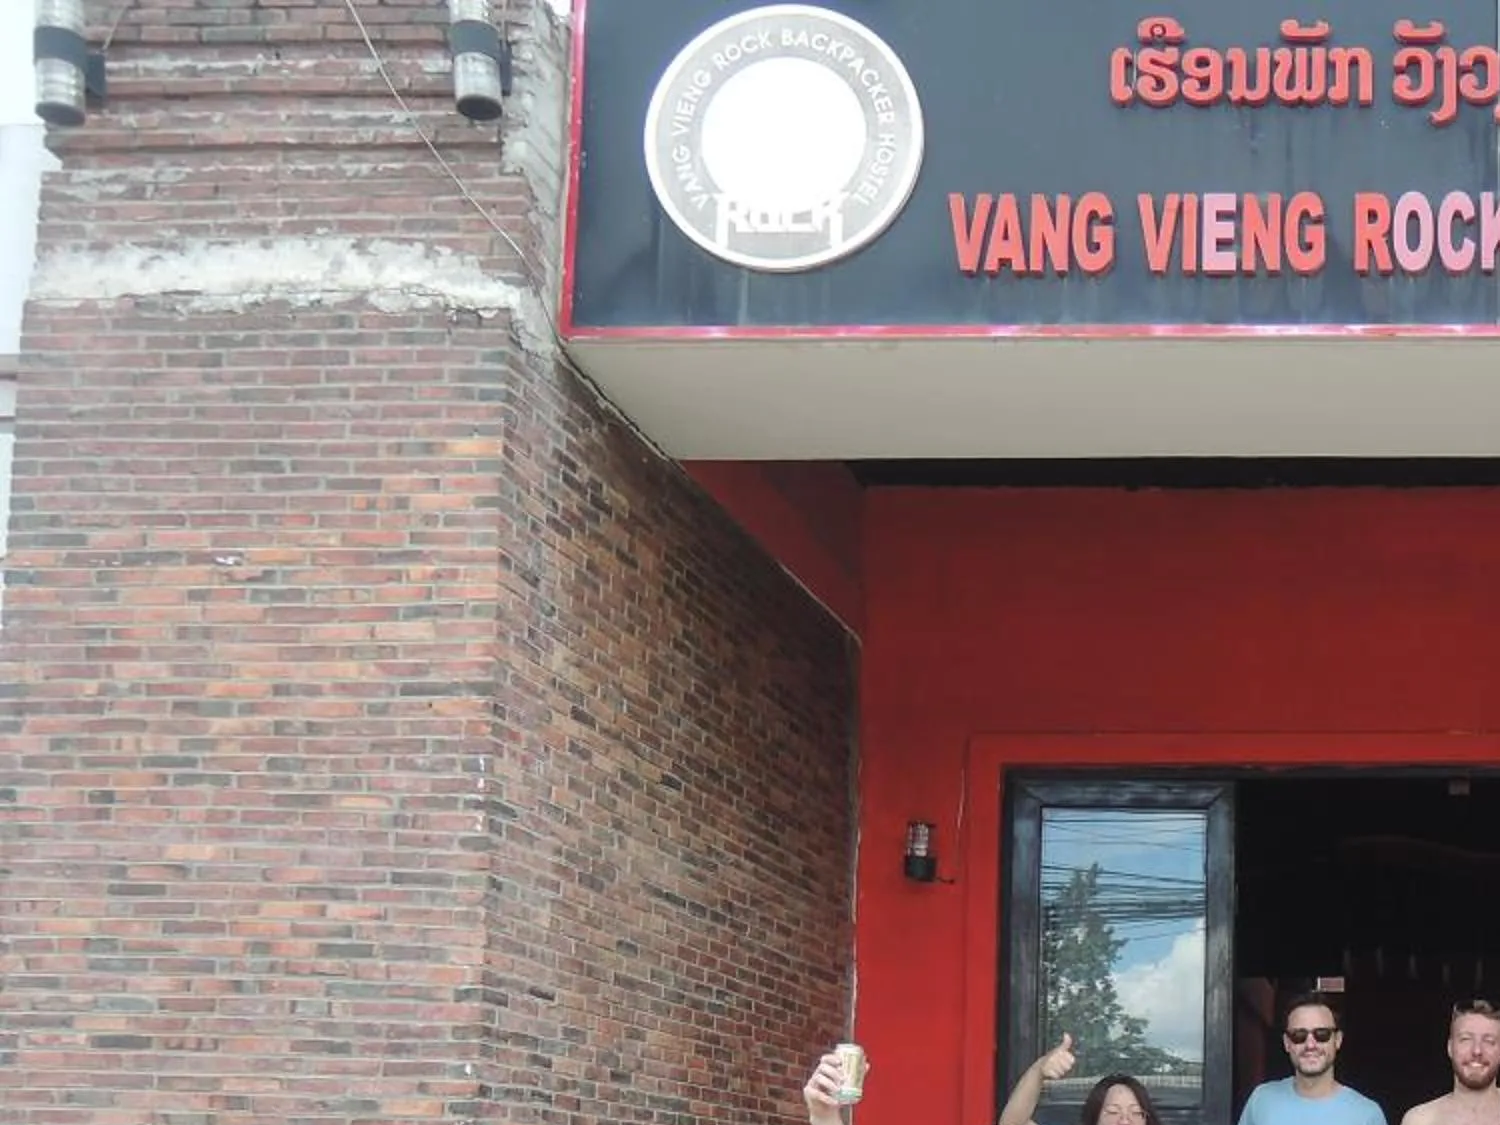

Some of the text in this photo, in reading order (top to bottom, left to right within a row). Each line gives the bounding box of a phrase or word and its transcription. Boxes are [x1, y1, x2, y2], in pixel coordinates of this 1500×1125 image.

[671, 27, 898, 212] VANG VIENG ROCK BACKPACKER HOSTEL
[949, 192, 1116, 278] VANG
[1137, 192, 1326, 278] VIENG
